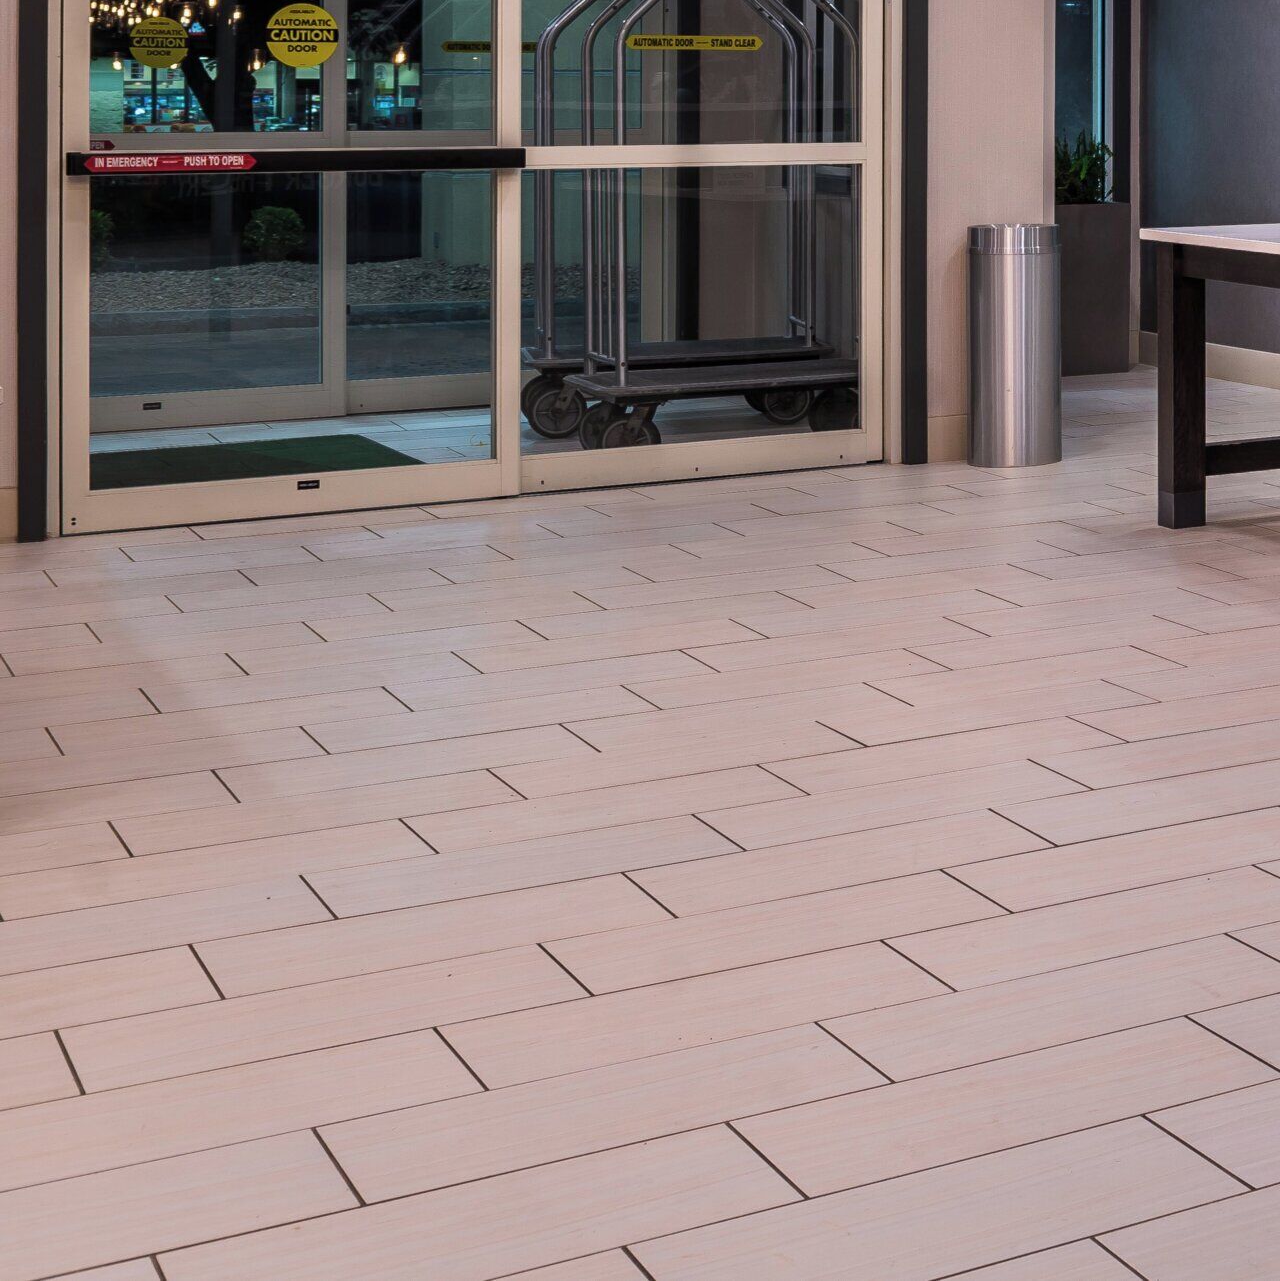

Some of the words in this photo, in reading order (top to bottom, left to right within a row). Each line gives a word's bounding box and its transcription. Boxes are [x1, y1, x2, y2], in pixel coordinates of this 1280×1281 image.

[273, 18, 332, 27] AUTOMATIC
[270, 30, 334, 41] CAUTION
[133, 38, 186, 47] CAUTION
[633, 38, 674, 47] AUTOMATIC
[675, 38, 694, 47] DOOR
[711, 39, 733, 47] STAND
[734, 39, 756, 48] CLEAR
[287, 45, 318, 53] DOOR
[91, 141, 105, 150] PEN
[94, 157, 104, 168] IN
[106, 156, 159, 168] EMERGENCY
[184, 156, 207, 167] PUSH
[208, 156, 220, 166] TO
[222, 155, 244, 166] OPEN
